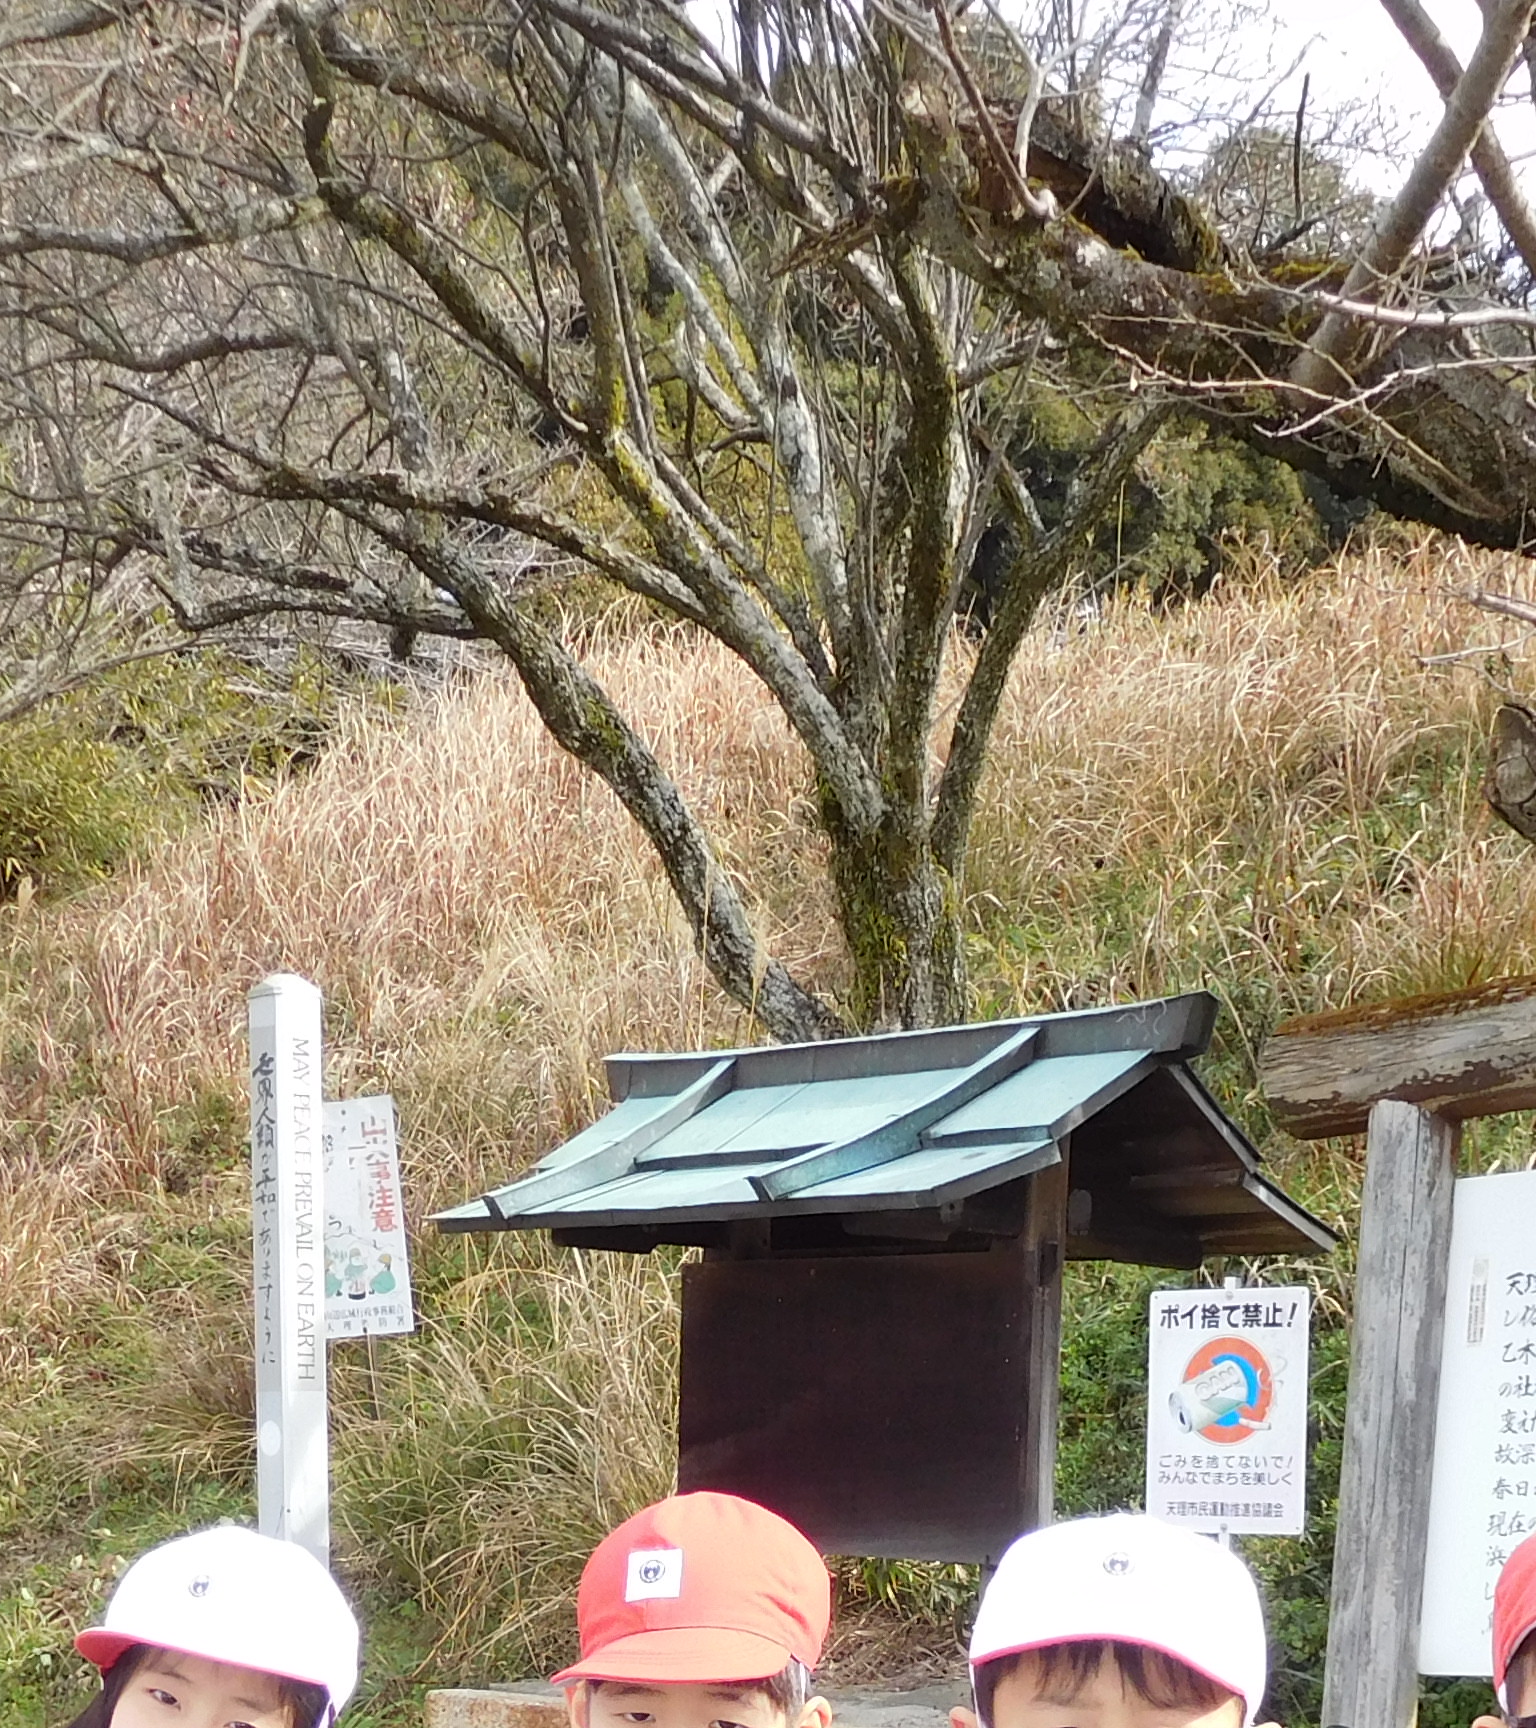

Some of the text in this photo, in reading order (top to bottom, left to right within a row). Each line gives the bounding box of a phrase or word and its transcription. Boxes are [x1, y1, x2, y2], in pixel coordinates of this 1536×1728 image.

[292, 1037, 316, 1380] MAY PEACE PREVAIL ON EARTH
[1160, 1301, 1298, 1330] ポイ捨て禁止！
[1159, 1454, 1294, 1469] ごみを捨てないで！
[1158, 1471, 1293, 1486] みんなでまちを美しく
[1166, 1501, 1284, 1518] 天理市民運動推進協議会
